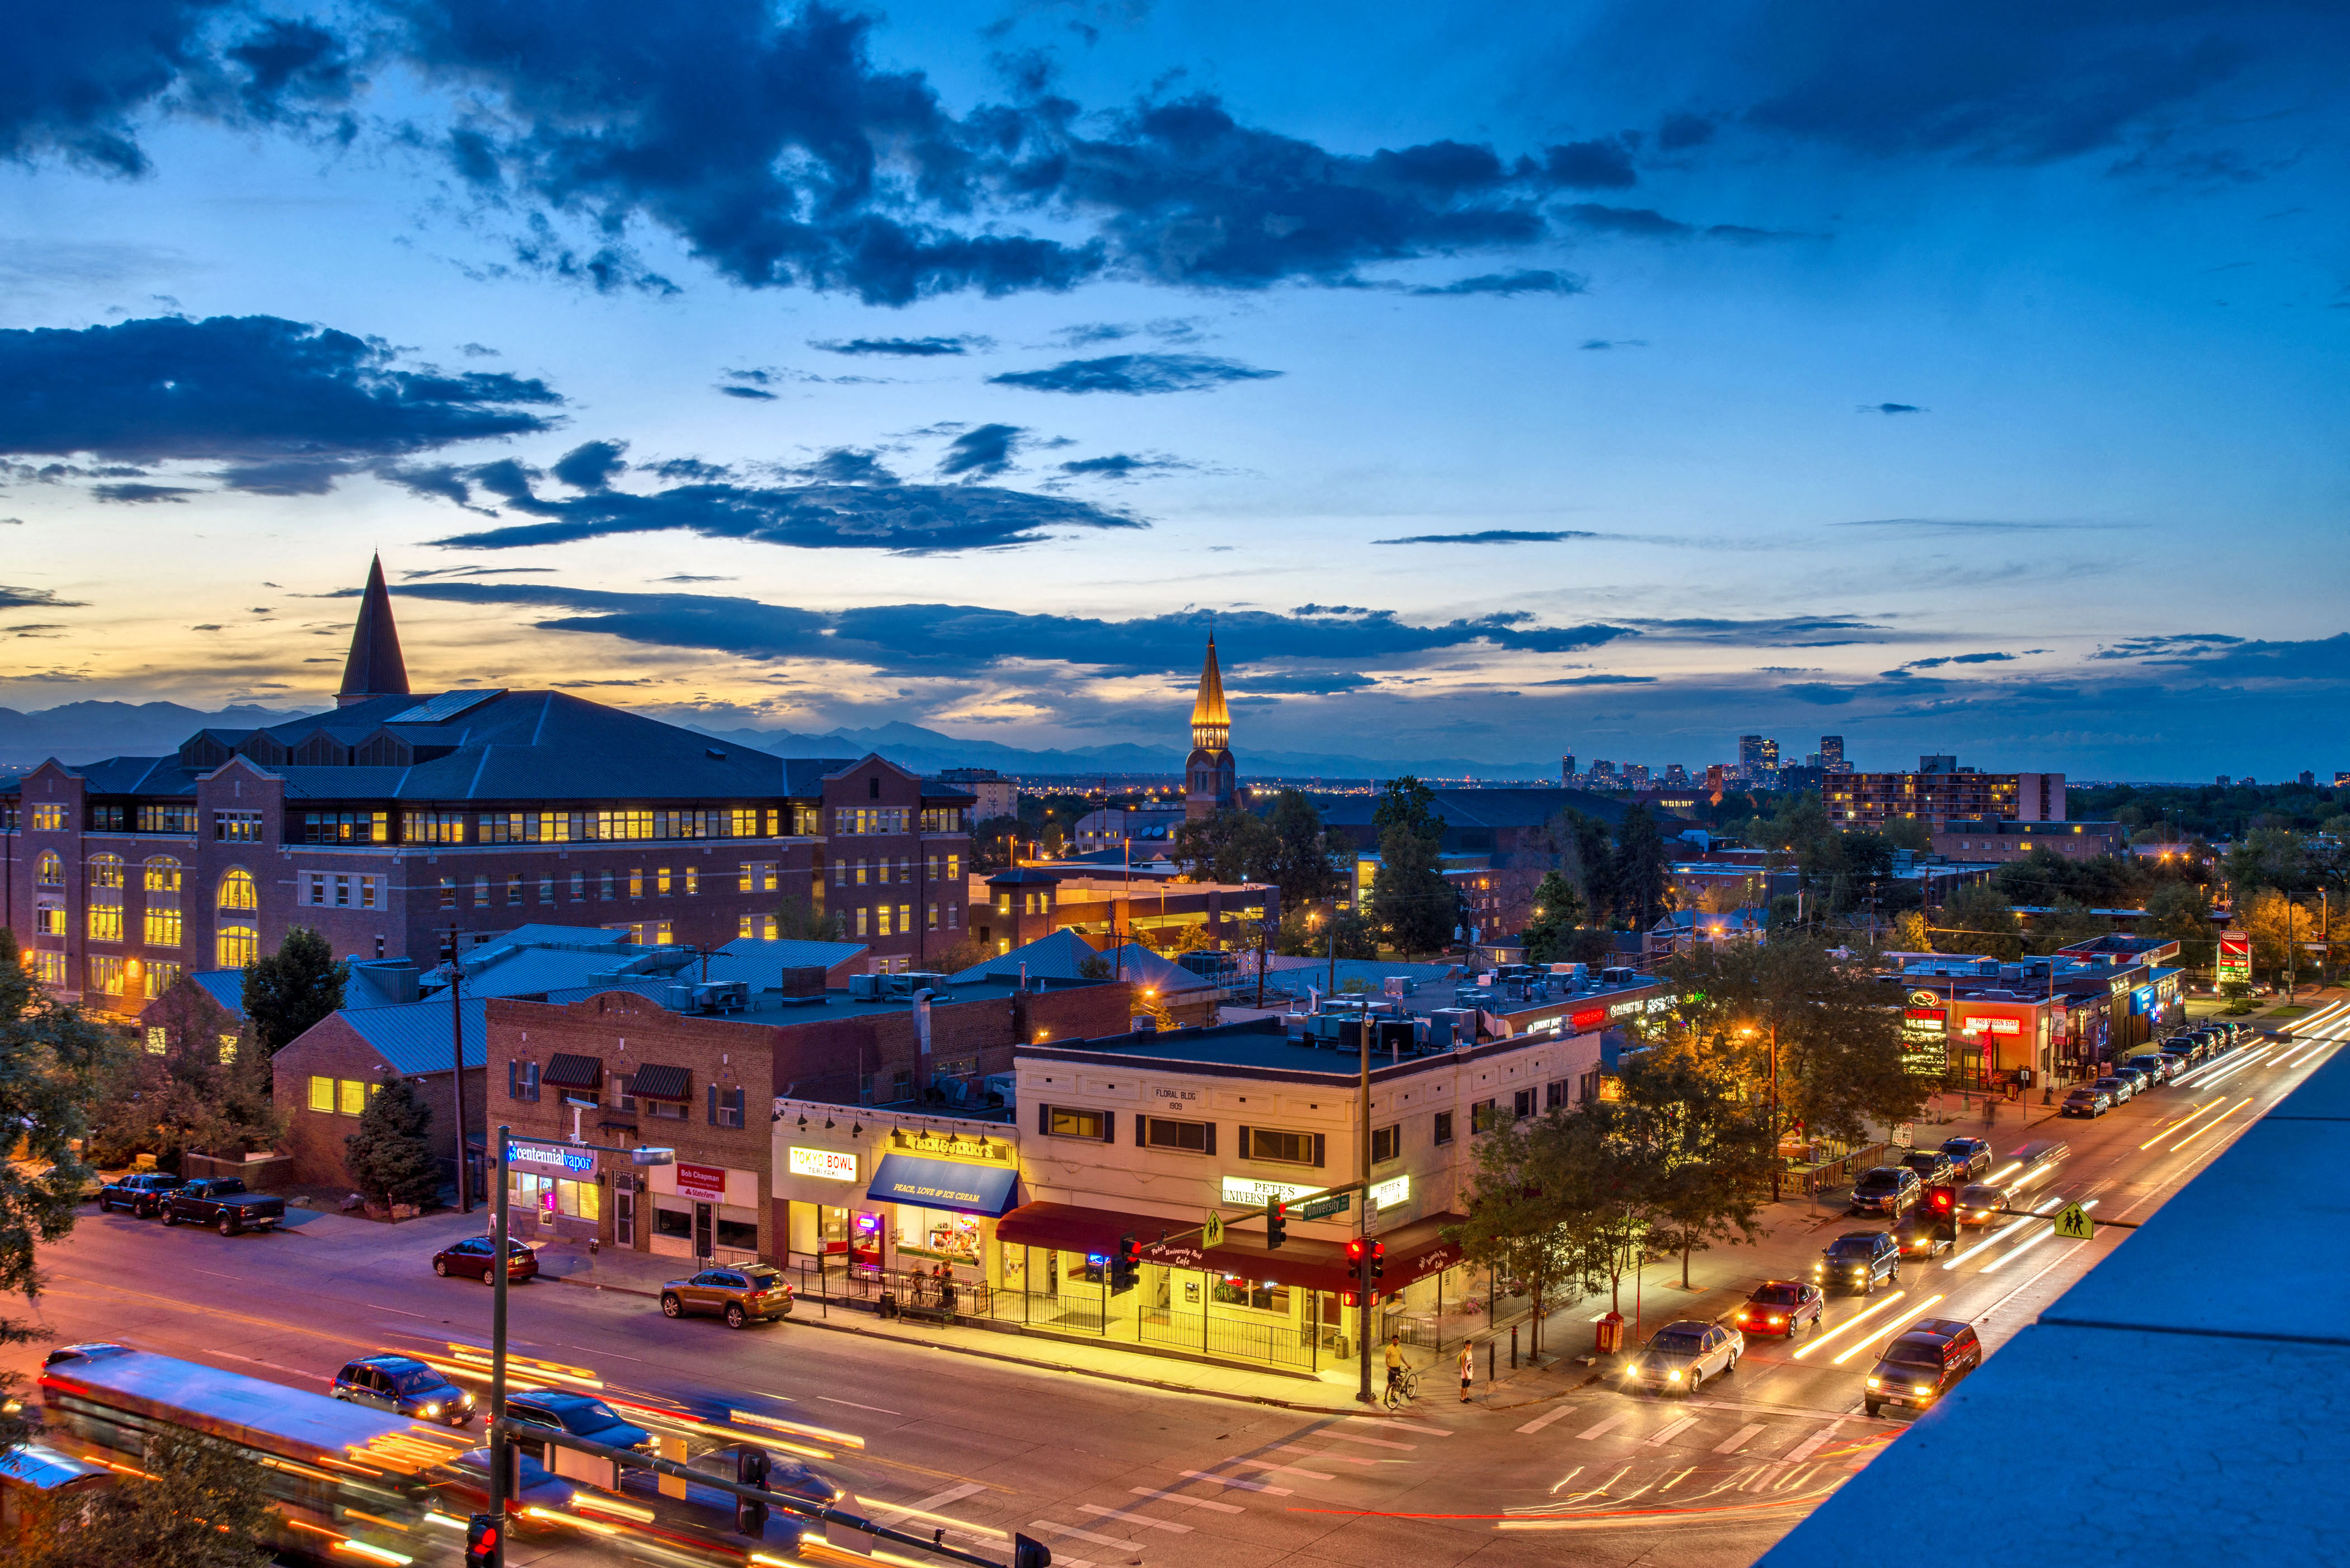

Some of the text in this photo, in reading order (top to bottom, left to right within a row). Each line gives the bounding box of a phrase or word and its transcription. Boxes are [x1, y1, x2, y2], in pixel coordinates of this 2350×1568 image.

[1534, 1019, 1550, 1032] JIMMY
[1156, 1089, 1178, 1099] FLORAL
[1169, 1102, 1182, 1110] 1909
[793, 1150, 853, 1170] TOKYO BOWL
[681, 1169, 719, 1182] Bob Chapman
[809, 1167, 838, 1177] TERIYAKI
[894, 1183, 915, 1194] PEACE,
[916, 1186, 936, 1196] LOVE
[943, 1190, 955, 1199] ICE
[955, 1192, 980, 1202] CREAM
[1254, 1183, 1295, 1196] PETE'S
[1380, 1181, 1400, 1194] PETE'S
[1308, 1199, 1340, 1217] University
[1151, 1244, 1203, 1260] Pete's University Park
[1176, 1256, 1190, 1266] Cafe
[1435, 1259, 1444, 1269] Cafe
